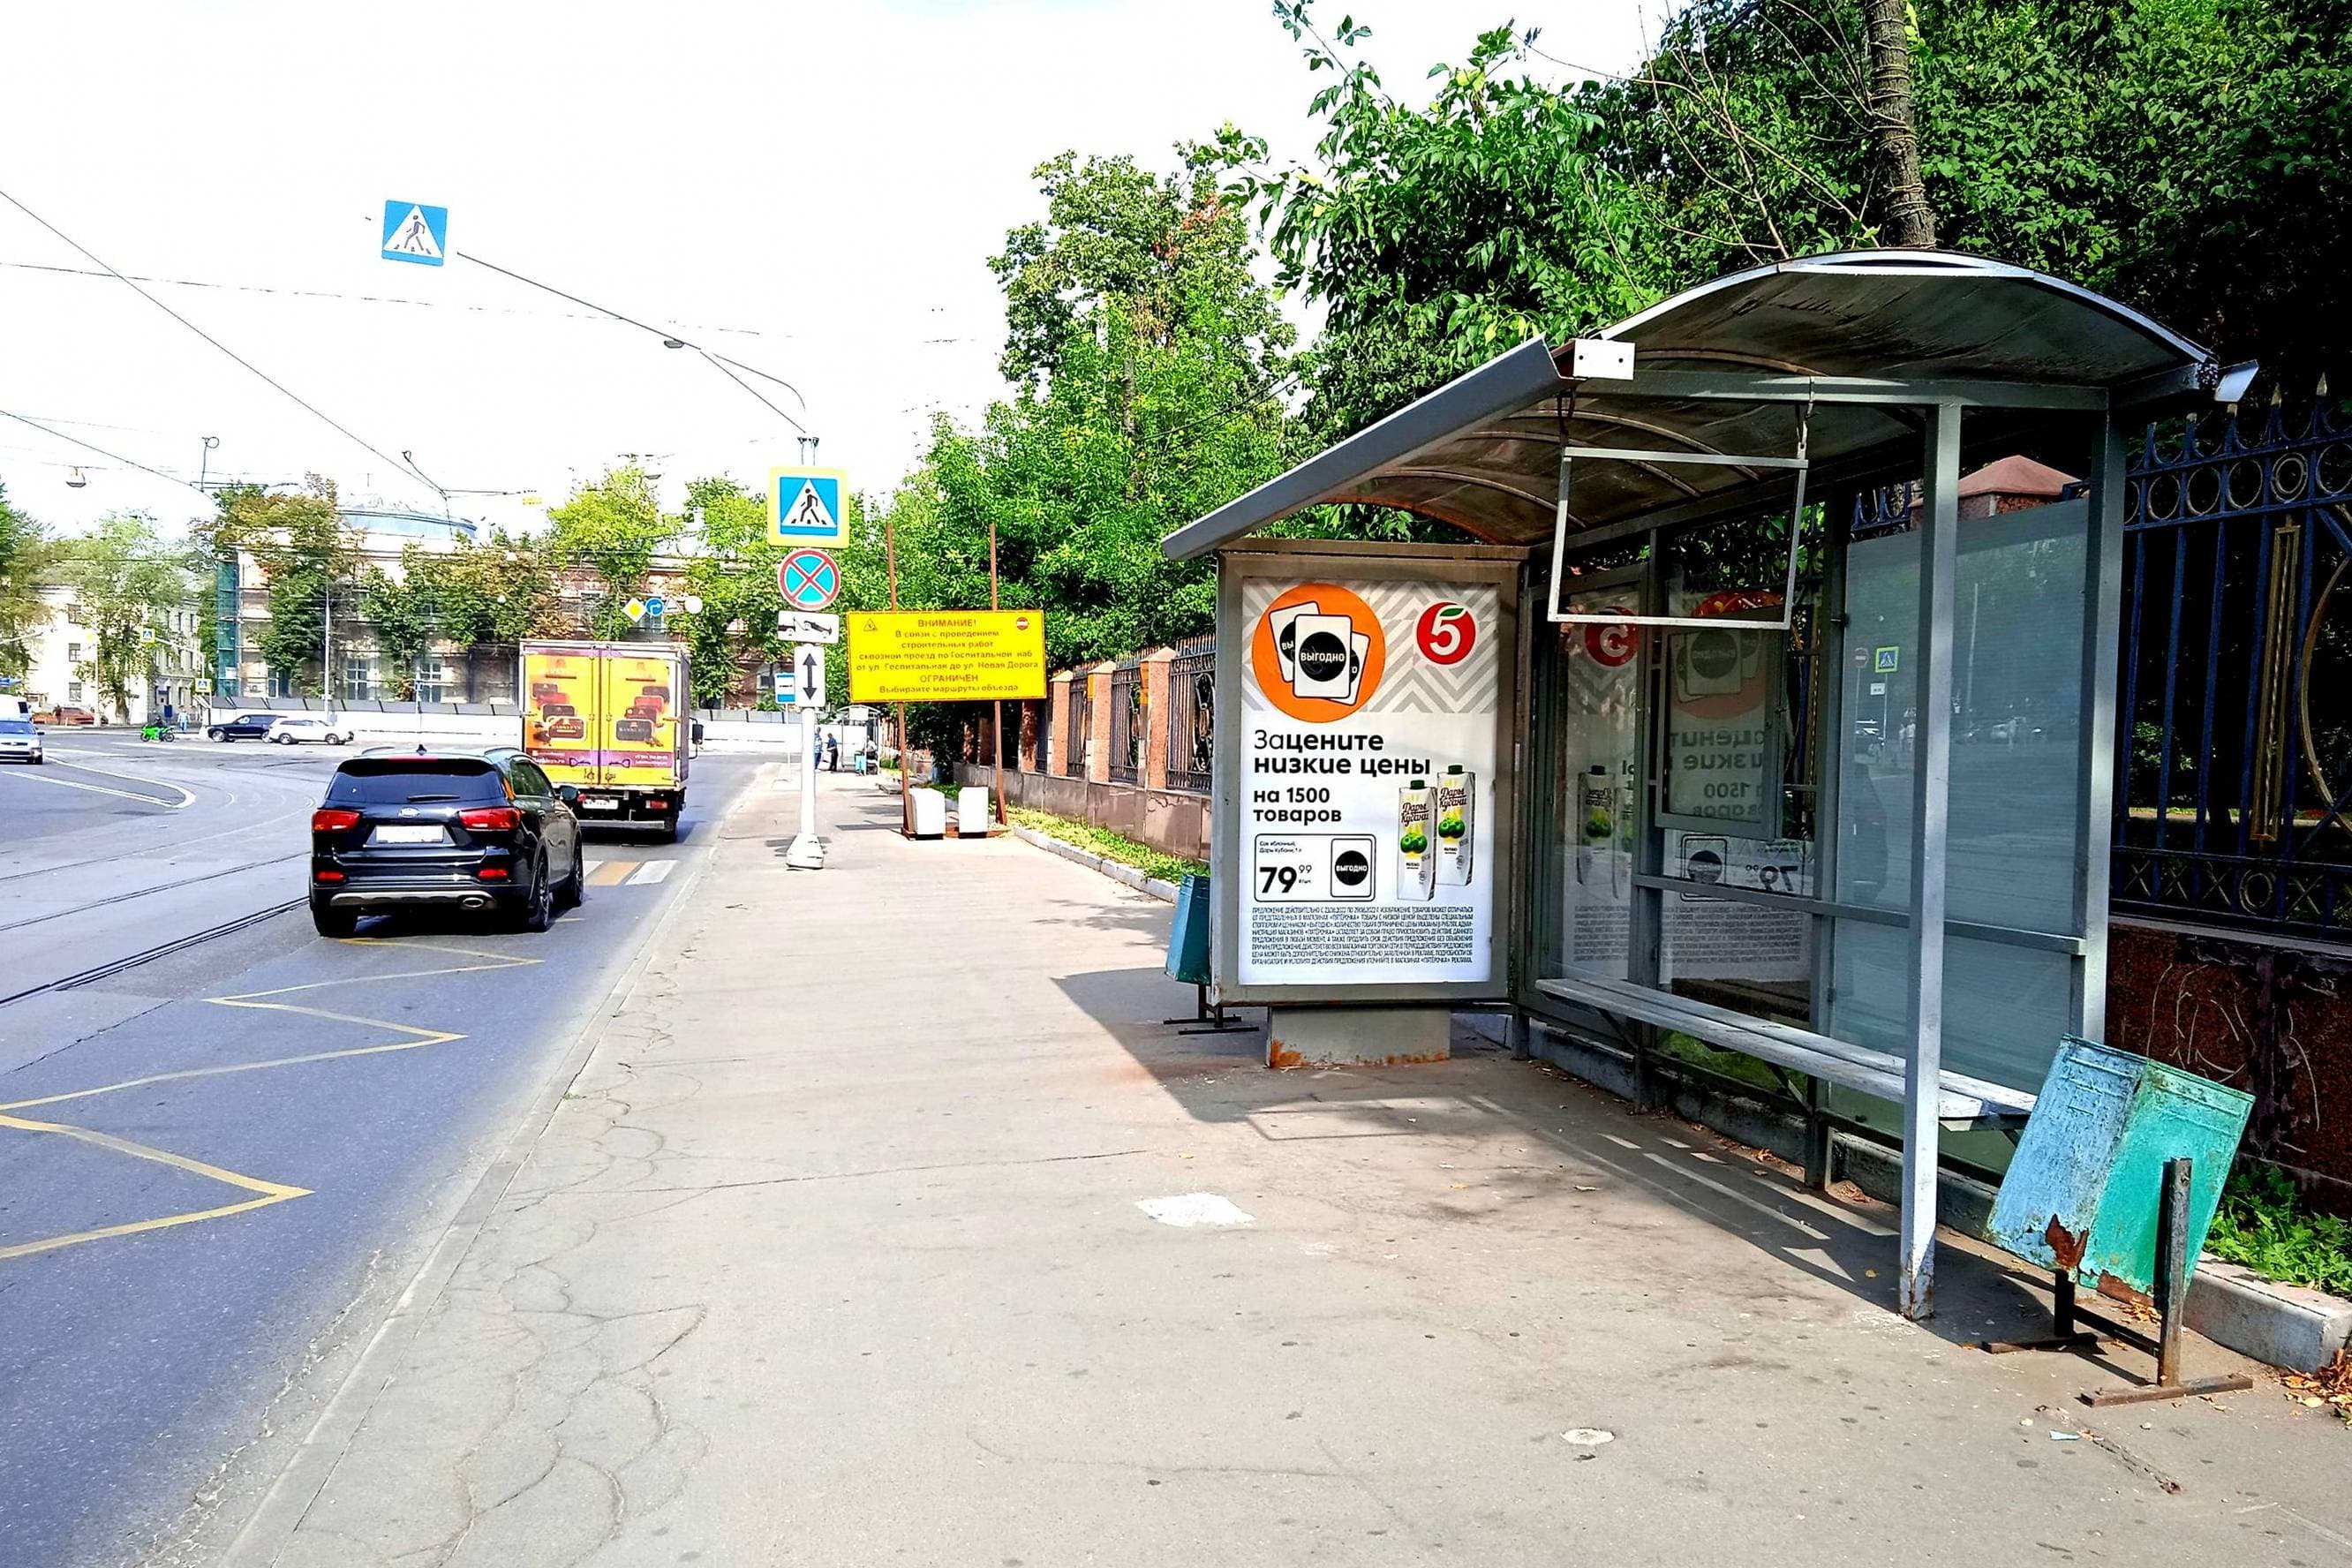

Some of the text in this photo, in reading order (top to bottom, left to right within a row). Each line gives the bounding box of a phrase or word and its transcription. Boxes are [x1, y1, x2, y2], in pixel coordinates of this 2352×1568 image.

[918, 619, 976, 628] ВНИМАНИЕ!
[1431, 605, 1464, 655] 5
[1300, 652, 1345, 663] ВЫГОДНО
[1006, 661, 1038, 670] Дорога
[920, 674, 978, 682] ОГРАНИЧЕН
[1255, 729, 1383, 751] Зацените
[1255, 758, 1430, 778] низкие цены
[1254, 788, 1330, 803] на 1500
[1254, 809, 1342, 825] товаров
[1299, 864, 1312, 874] 99
[1336, 864, 1368, 873] ВЫГОДНО
[1259, 867, 1297, 893] 79
